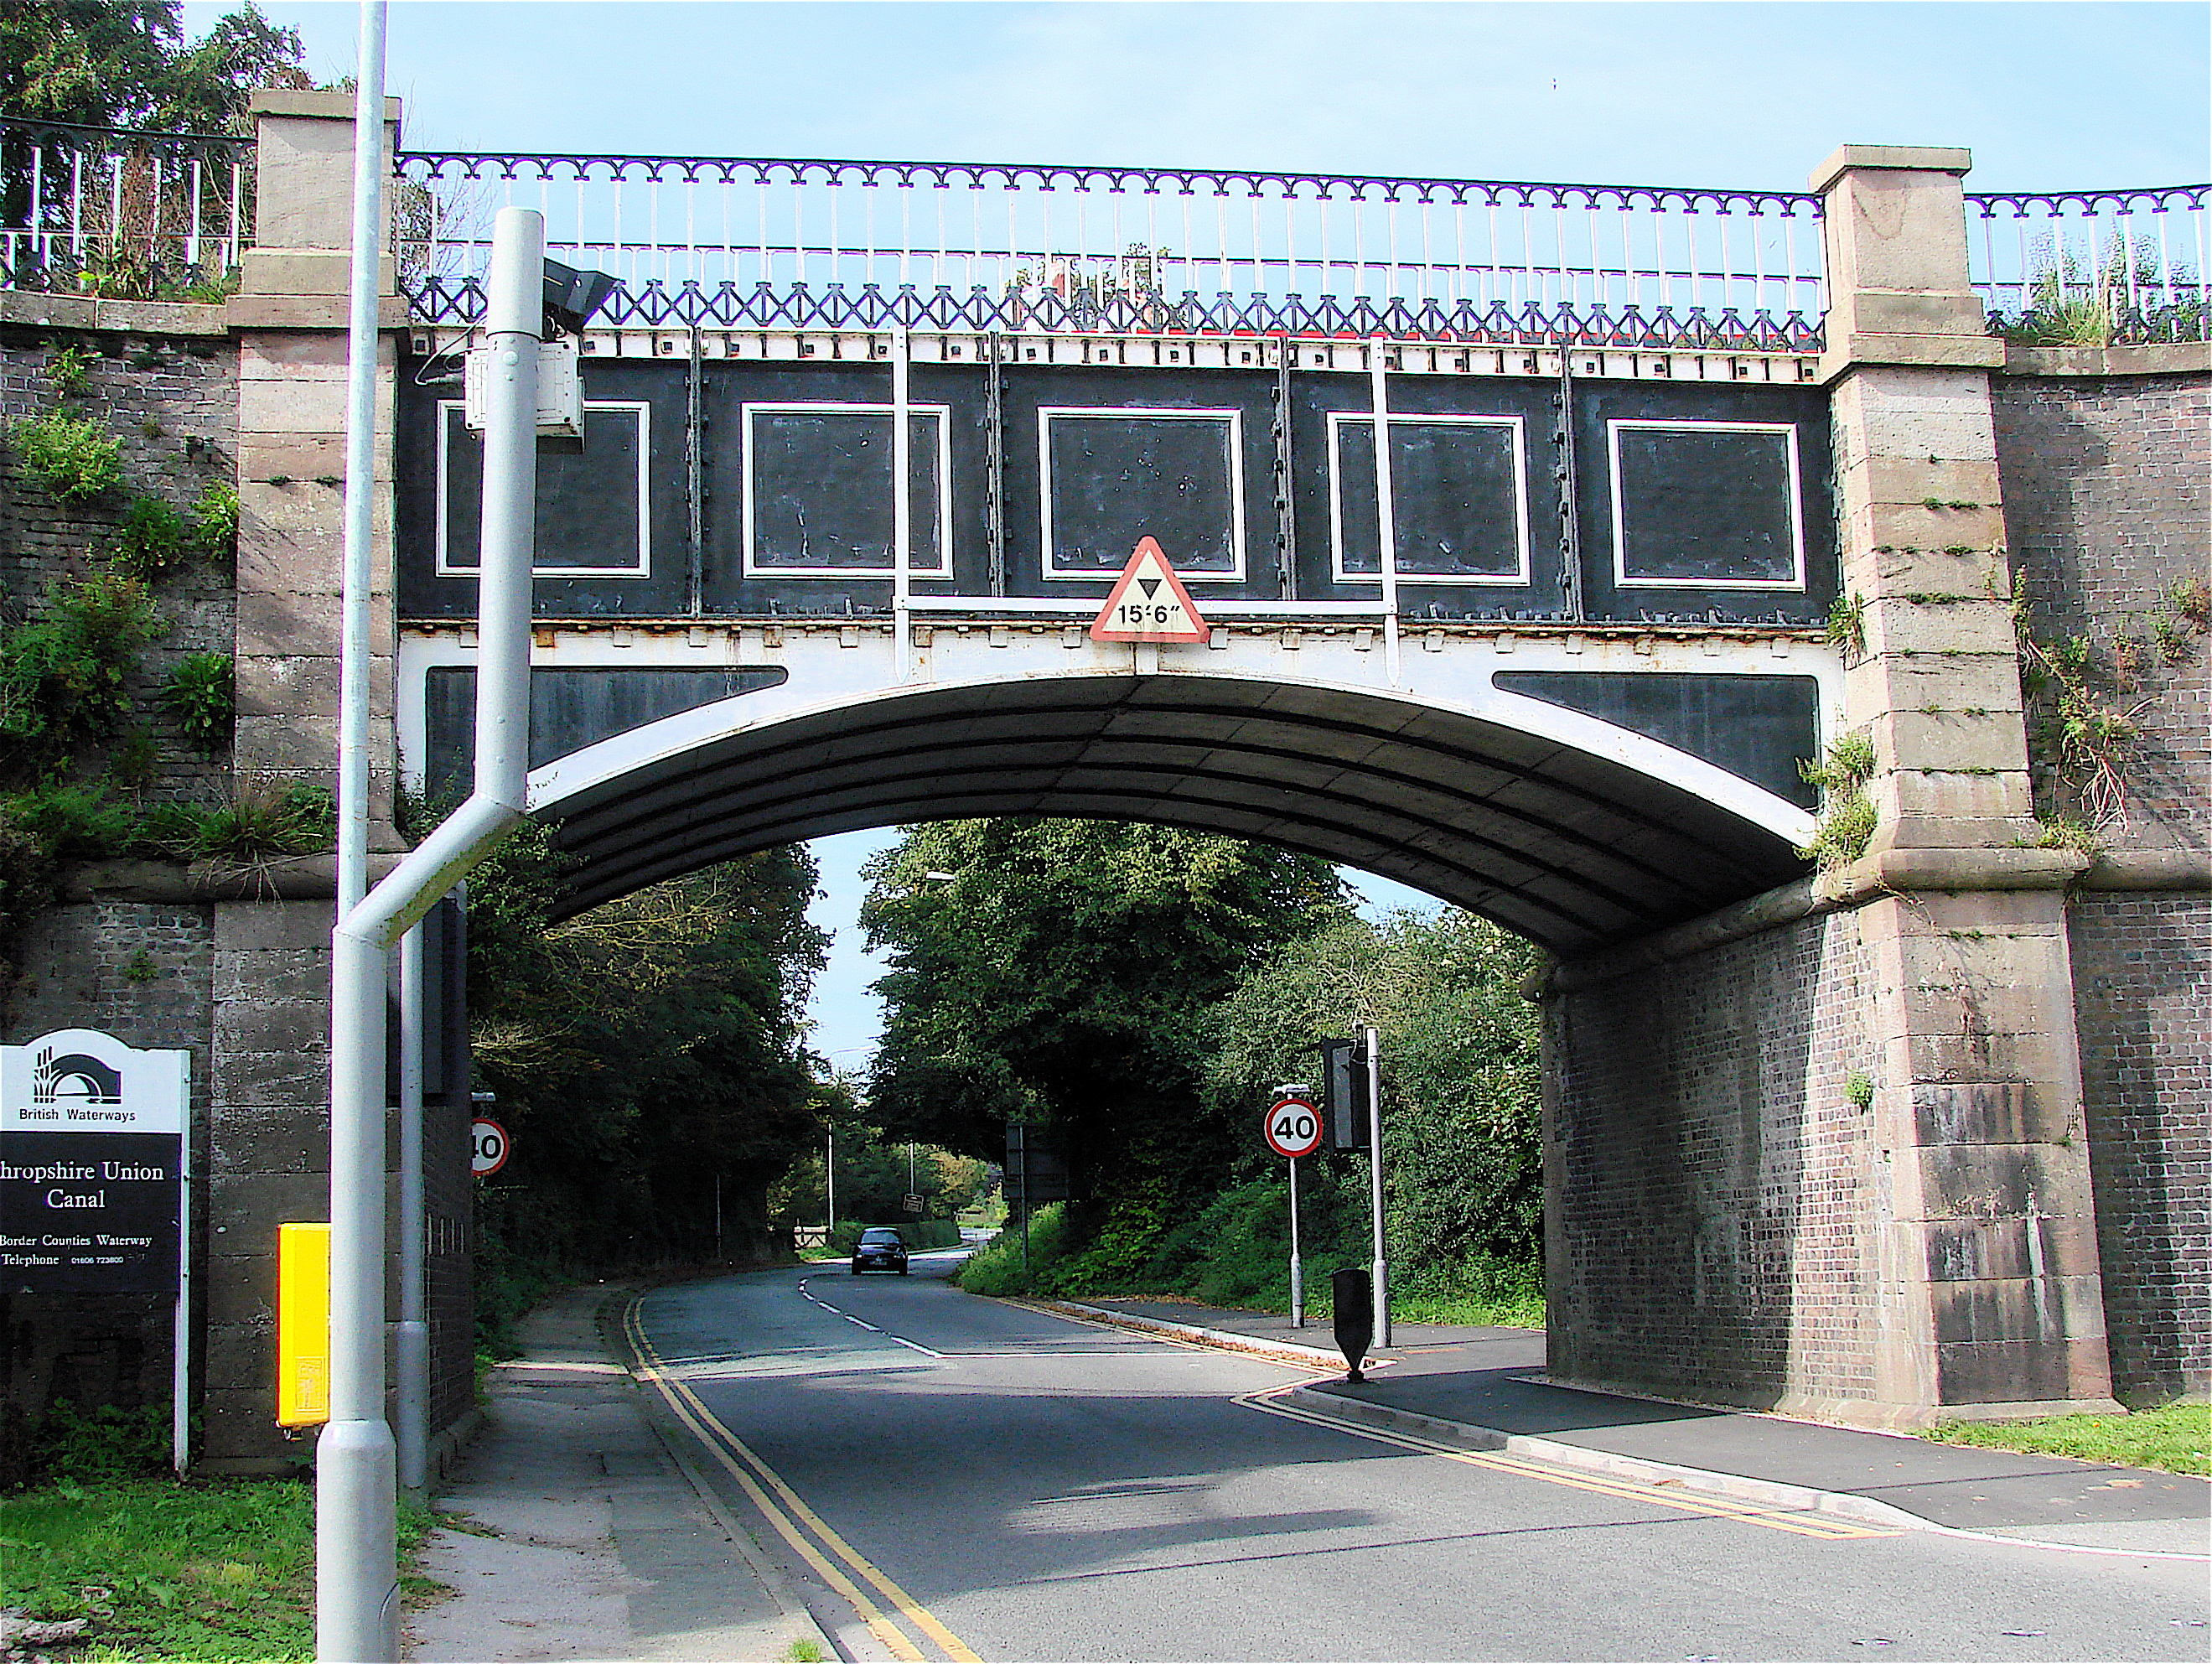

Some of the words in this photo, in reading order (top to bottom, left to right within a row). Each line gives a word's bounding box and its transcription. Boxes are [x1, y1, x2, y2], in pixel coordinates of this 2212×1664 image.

[19, 1108, 59, 1120] British
[67, 1108, 136, 1122] Waterways
[1274, 1115, 1314, 1139] 40
[101, 1161, 164, 1180] Union
[47, 1189, 106, 1208] Canal
[0, 1234, 38, 1246] Border
[42, 1234, 91, 1246] Counties
[96, 1234, 153, 1247] Waterway
[1, 1253, 60, 1267] Telephone
